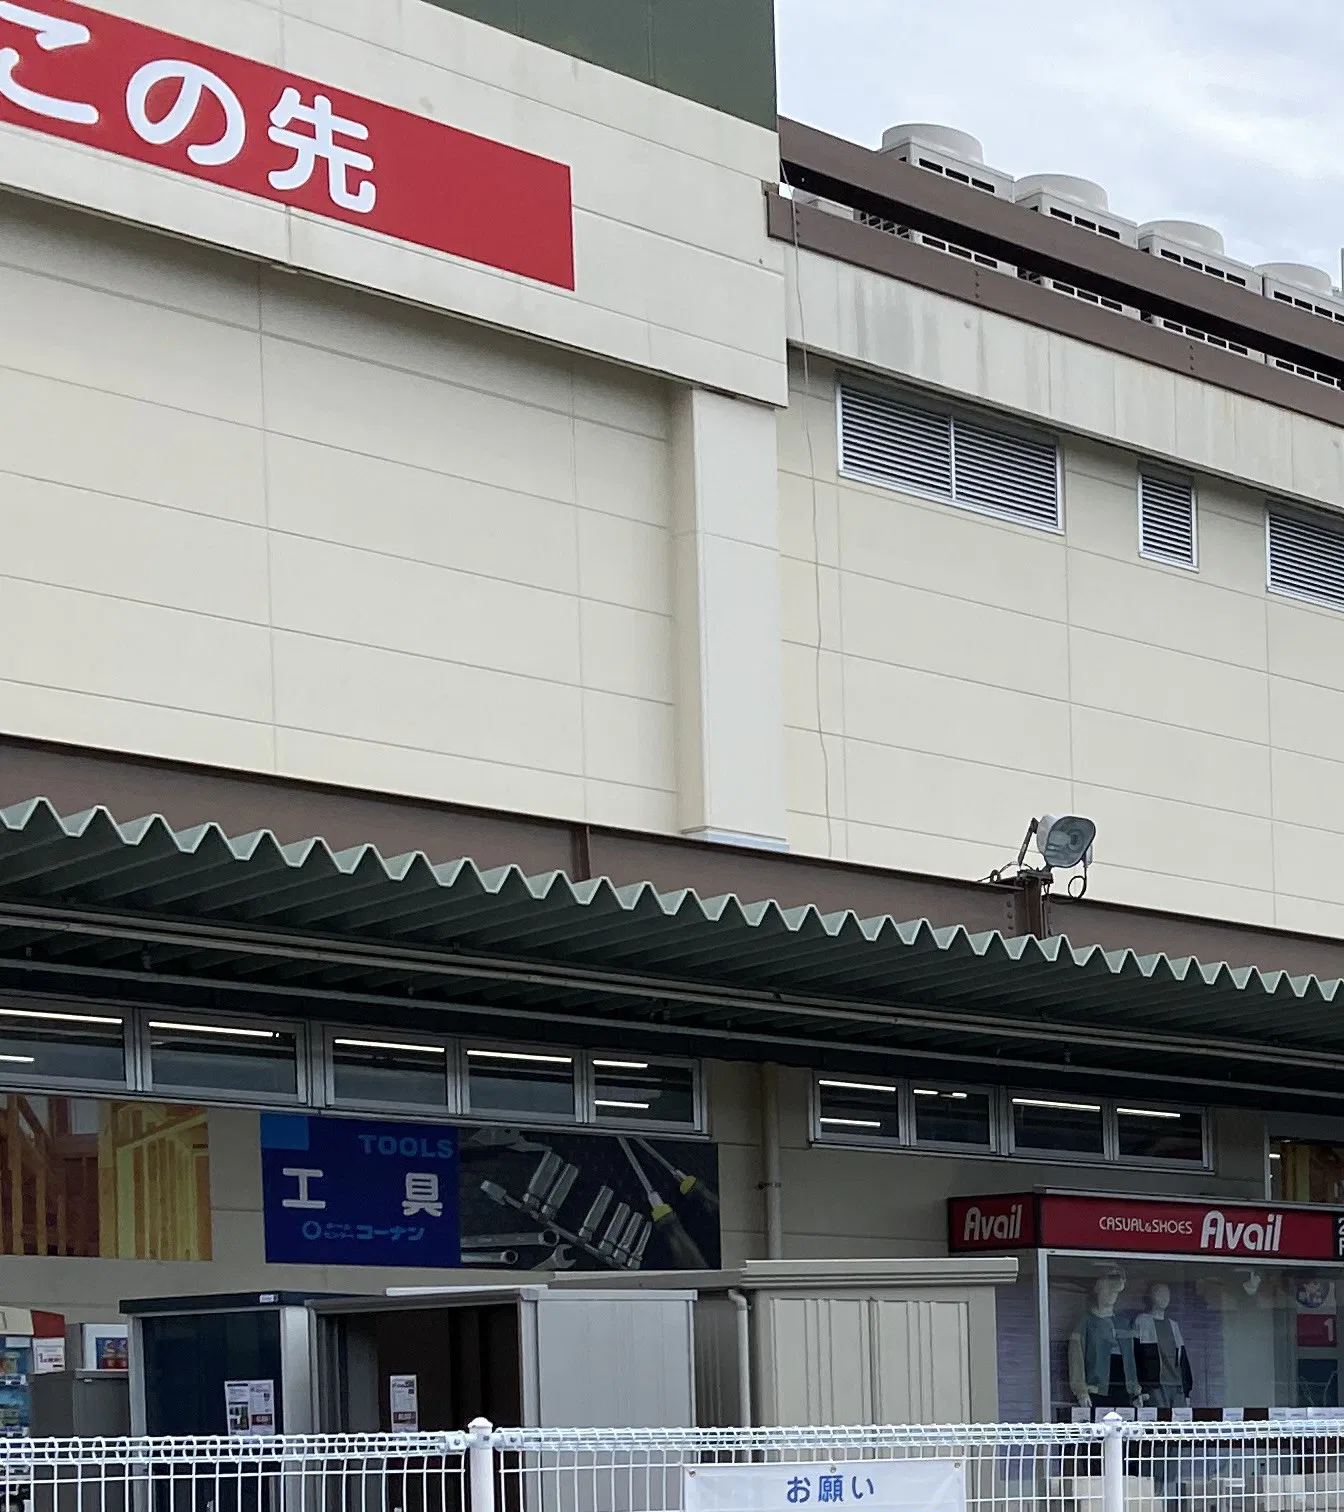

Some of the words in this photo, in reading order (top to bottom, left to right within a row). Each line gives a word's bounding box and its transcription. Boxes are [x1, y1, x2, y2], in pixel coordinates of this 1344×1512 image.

[0, 0, 376, 213] この先
[358, 1134, 454, 1158] TOOLS
[356, 1224, 425, 1241] コーナン
[963, 1204, 1022, 1241] Avail
[1099, 1216, 1193, 1235] CASUAL&SHOES
[1200, 1209, 1282, 1252] Avail
[787, 1474, 875, 1503] お願い
